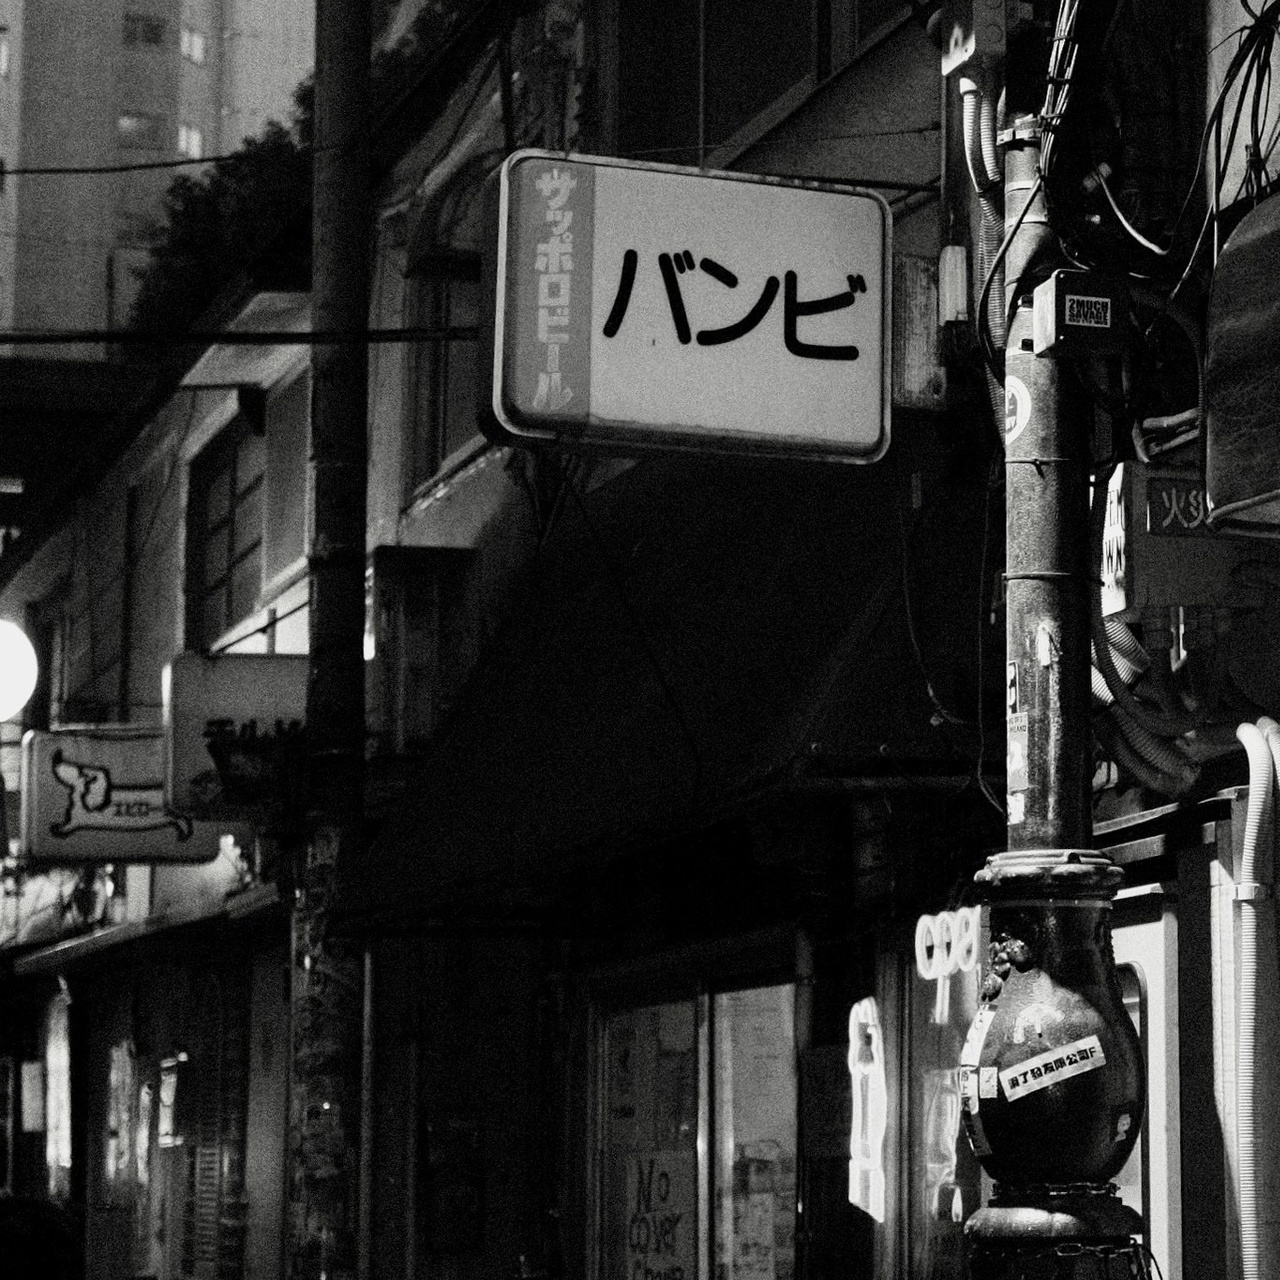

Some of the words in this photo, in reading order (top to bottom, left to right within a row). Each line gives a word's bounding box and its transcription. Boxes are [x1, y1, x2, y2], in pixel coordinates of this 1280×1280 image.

[533, 169, 577, 411] サッポロビール
[603, 249, 867, 360] バンビ
[1068, 298, 1109, 313] 2MUCH
[1068, 307, 1109, 321] SAVAGE
